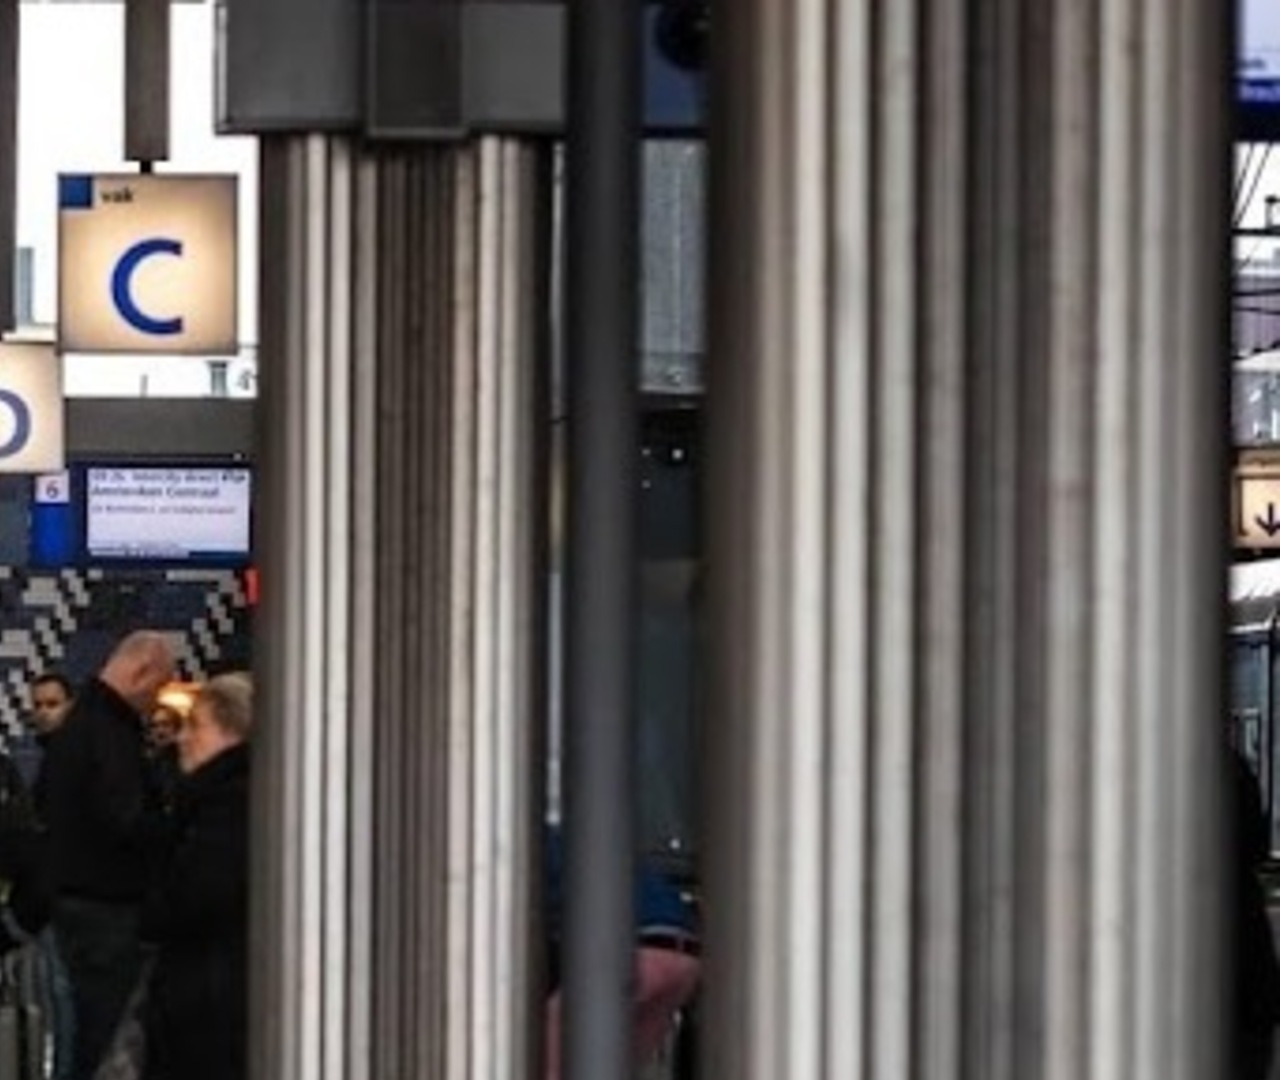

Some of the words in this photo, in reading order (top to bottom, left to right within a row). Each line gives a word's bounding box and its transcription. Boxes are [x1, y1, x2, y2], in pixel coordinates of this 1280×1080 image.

[101, 187, 133, 203] vak
[111, 238, 183, 335] C
[46, 480, 59, 499] 6
